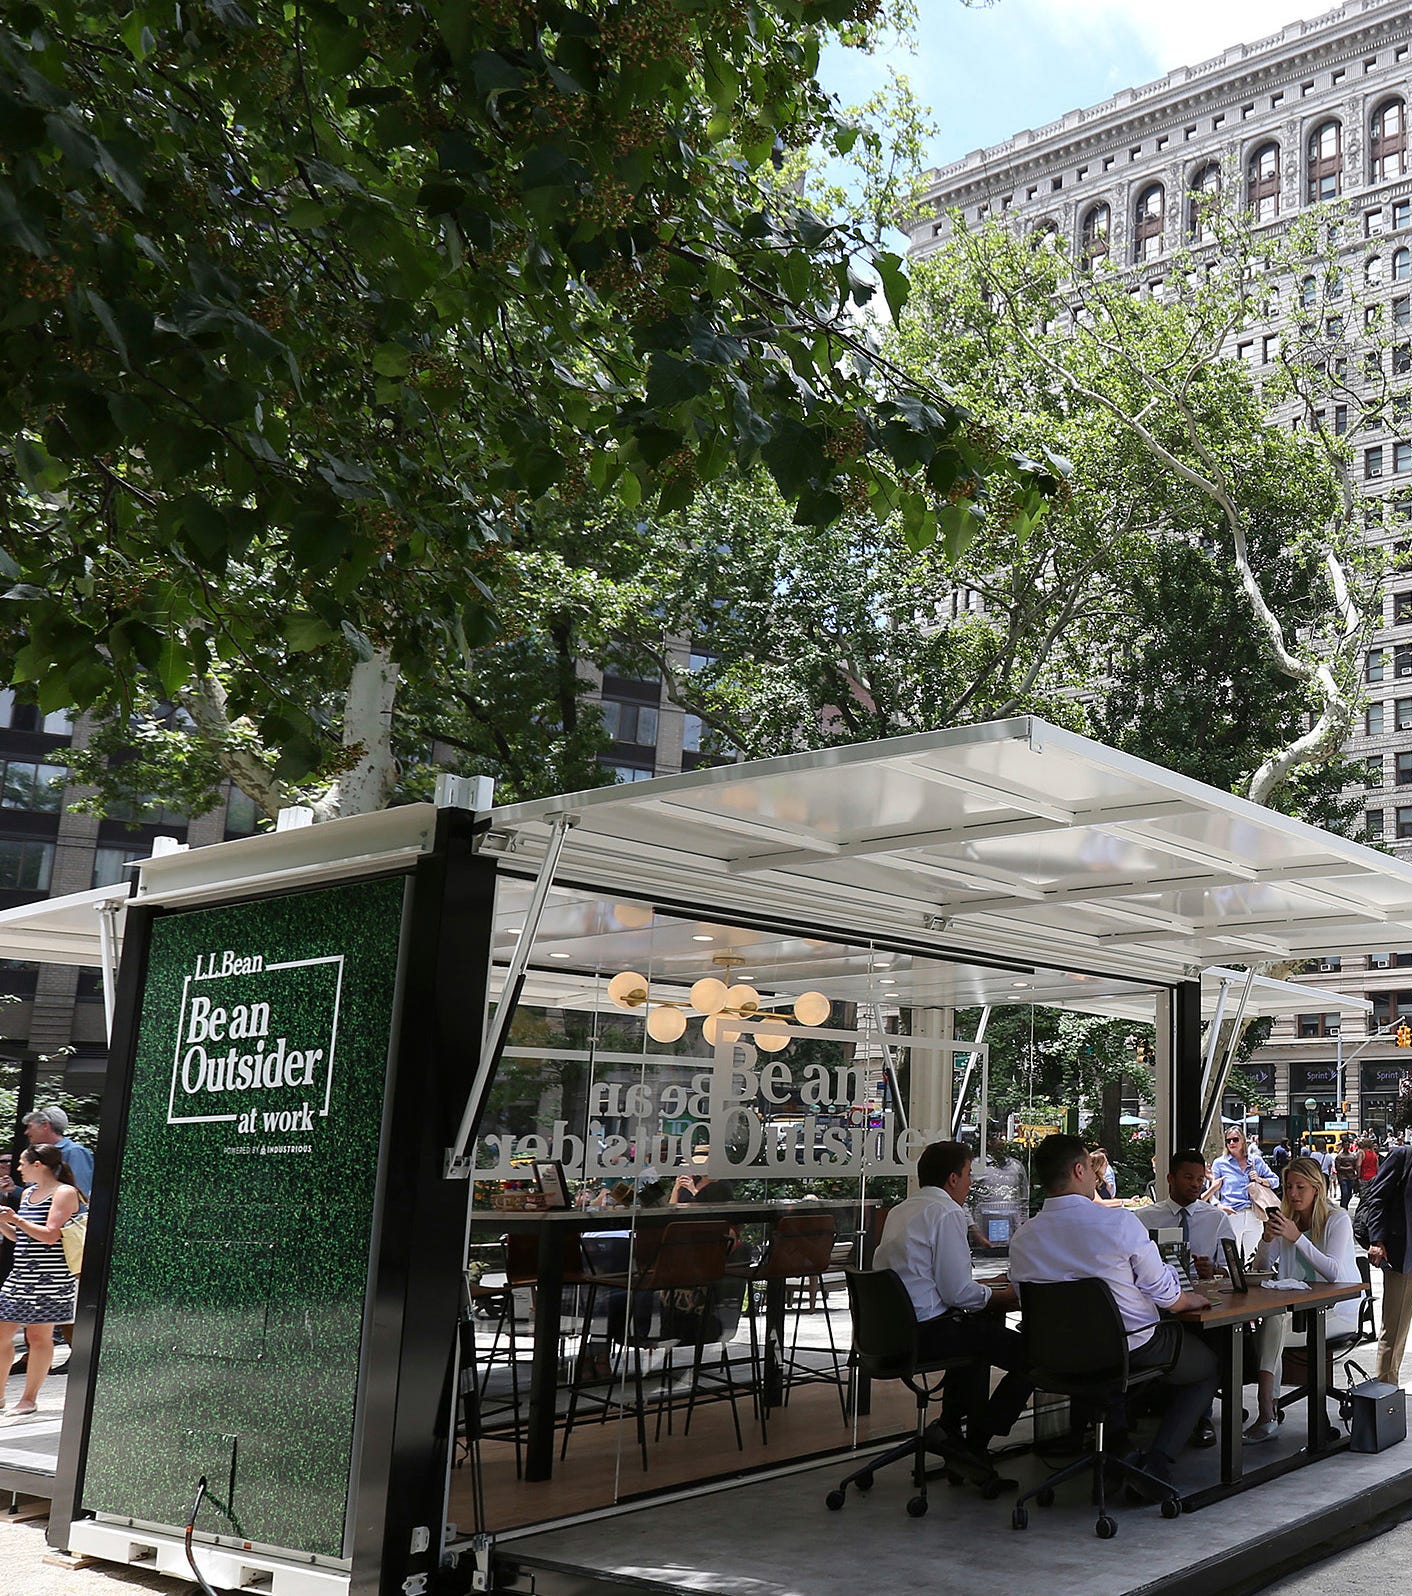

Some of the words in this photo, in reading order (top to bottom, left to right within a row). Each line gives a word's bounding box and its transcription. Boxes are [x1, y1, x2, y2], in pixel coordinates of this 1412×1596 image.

[194, 950, 264, 982] L.L.Bean
[185, 996, 228, 1044] Be
[230, 1001, 270, 1038] an
[181, 1038, 323, 1095] Outsider
[718, 1041, 793, 1104] Be
[800, 1063, 866, 1106] an
[1307, 1071, 1328, 1081] Sprint
[1376, 1071, 1398, 1081] Sprint
[237, 1109, 257, 1134] at
[262, 1102, 315, 1133] work
[267, 1144, 313, 1154] INDUSTRIOUS
